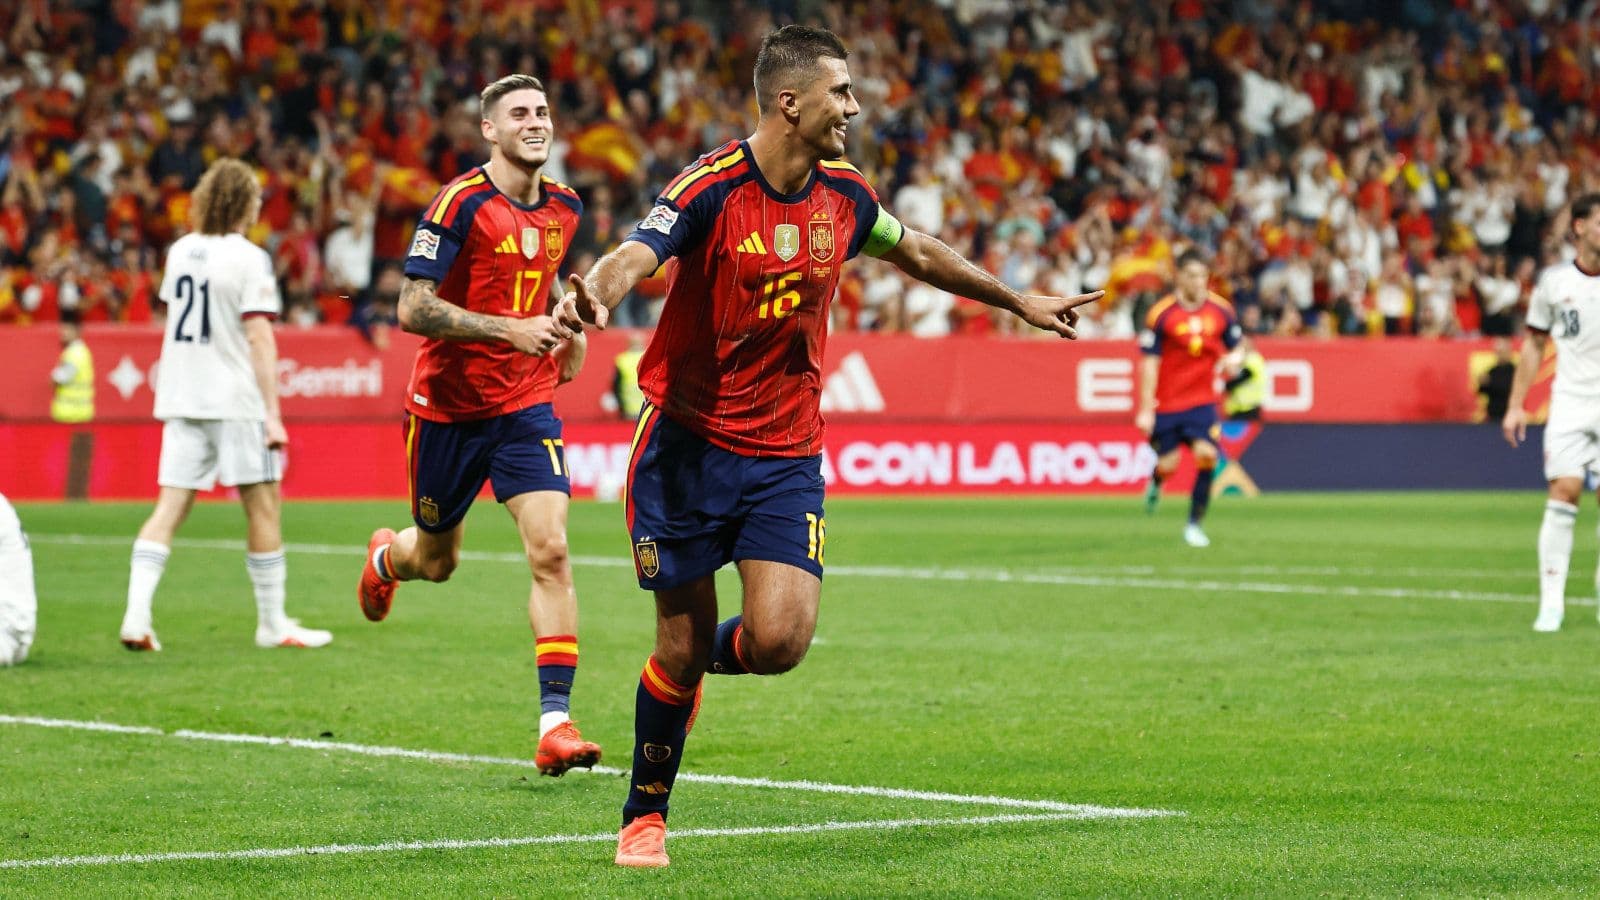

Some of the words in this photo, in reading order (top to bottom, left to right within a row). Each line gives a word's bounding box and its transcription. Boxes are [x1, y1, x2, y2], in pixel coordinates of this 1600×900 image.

[175, 275, 210, 343] 21
[512, 270, 543, 312] 17
[758, 271, 803, 319] 16
[277, 357, 383, 398] Gemini
[838, 440, 951, 486] CON
[957, 440, 1026, 485] LA
[1028, 440, 1159, 486] ROJA
